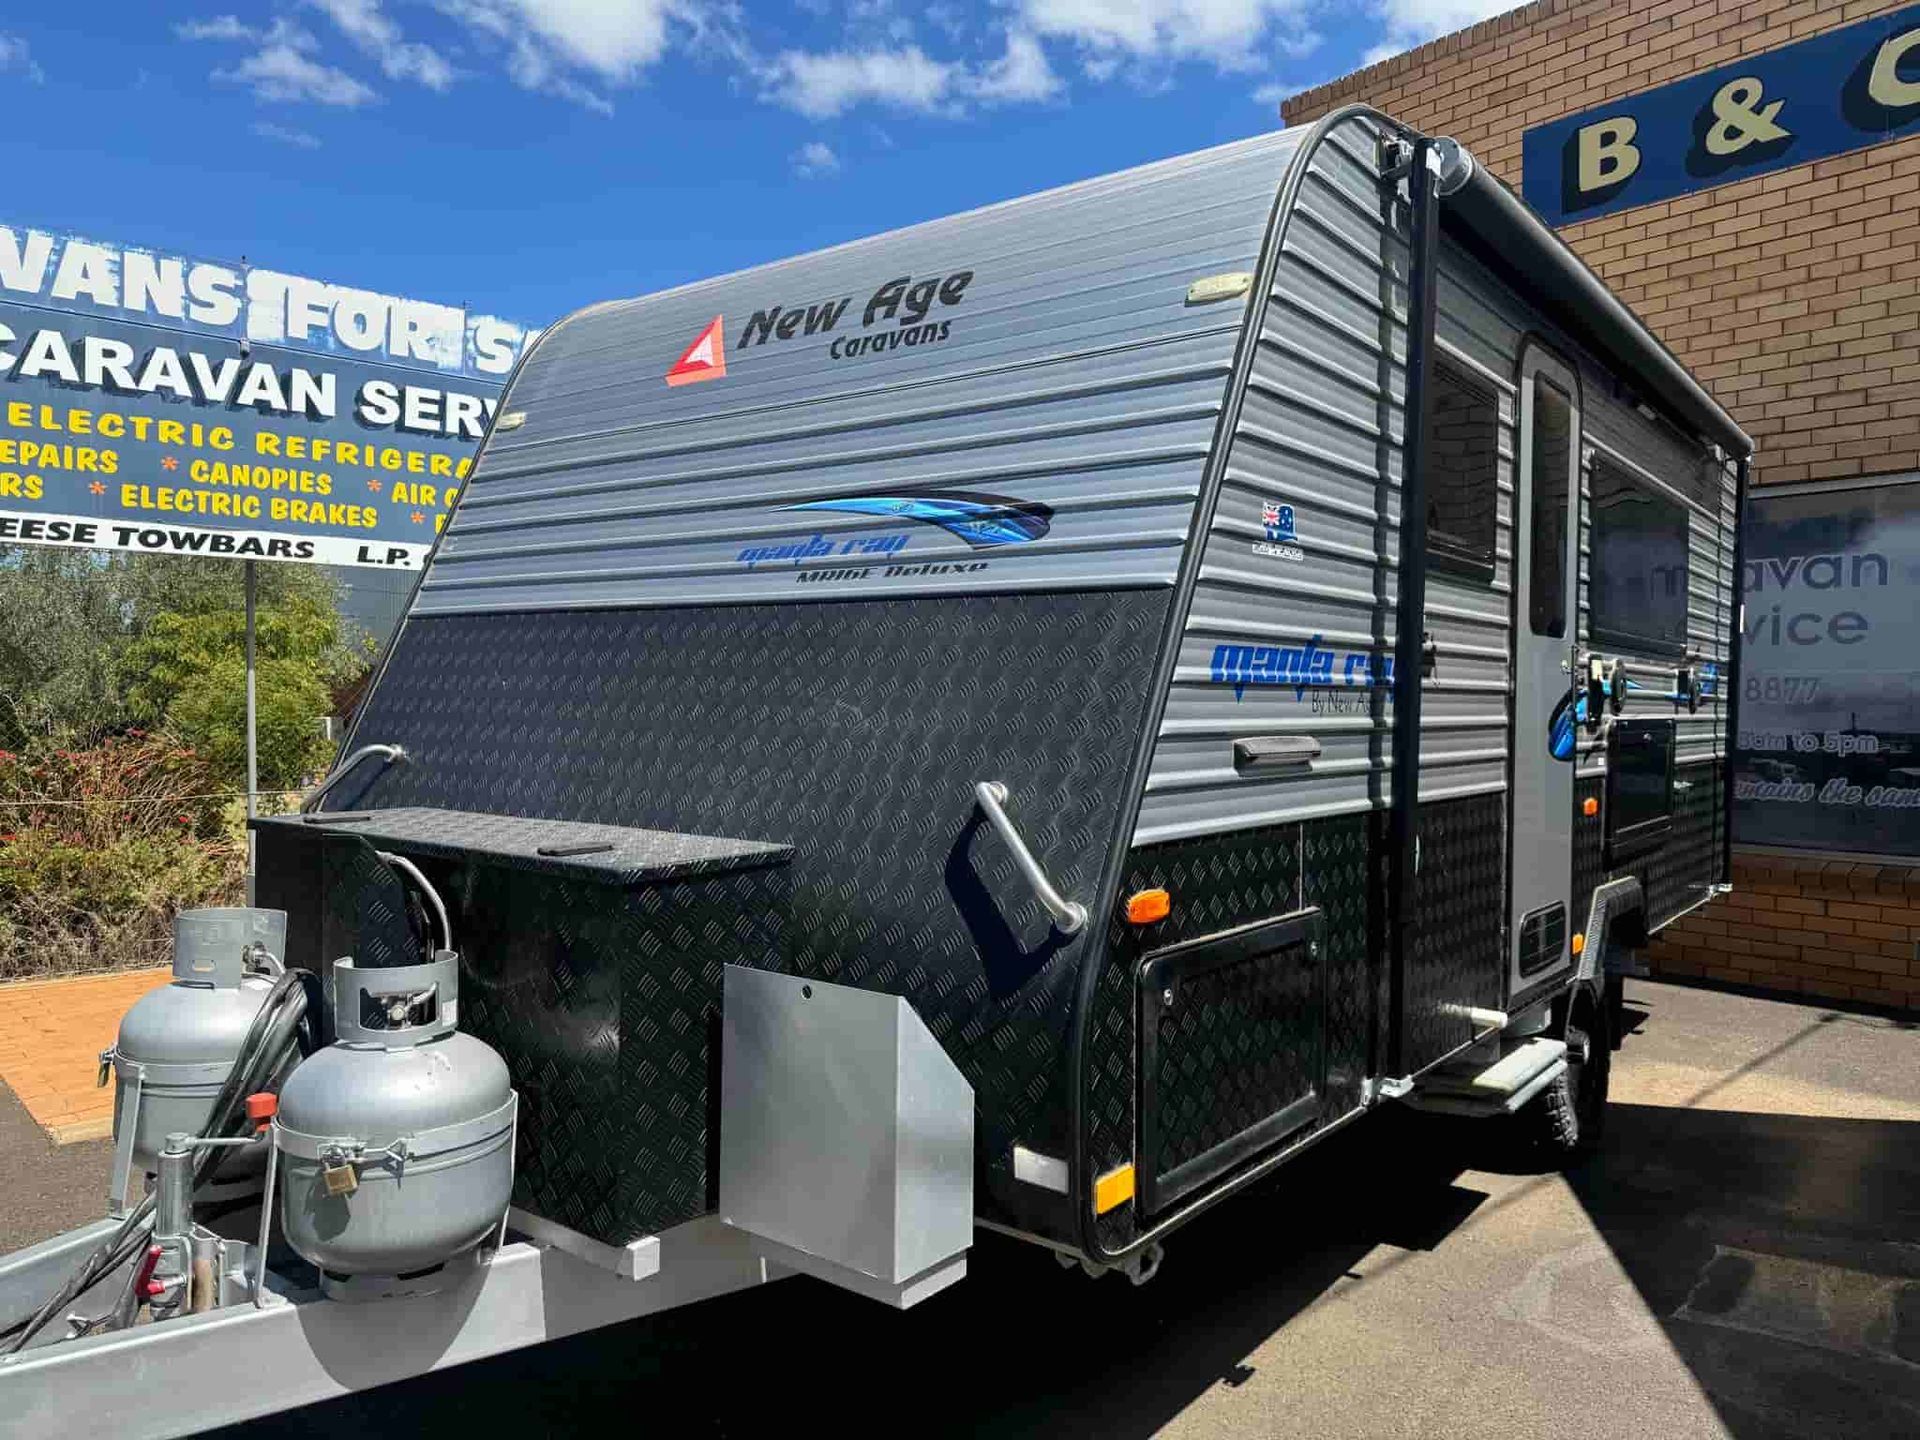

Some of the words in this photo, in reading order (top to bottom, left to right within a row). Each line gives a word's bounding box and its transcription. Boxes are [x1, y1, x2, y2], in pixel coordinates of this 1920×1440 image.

[1579, 117, 1641, 192] B
[1706, 77, 1792, 155] &
[0, 225, 241, 325] VANS
[474, 315, 540, 374] S
[737, 297, 851, 350] New
[863, 270, 974, 329] Age
[829, 318, 952, 360] Caravans
[8, 401, 235, 450] ELECTRIC
[190, 459, 333, 496] CANOPIES
[391, 480, 437, 507] AIR
[120, 483, 262, 519] ELECTRIC
[270, 497, 379, 529] BRAKES
[112, 526, 315, 560] TOWBARS
[1211, 634, 1335, 704] manta
[1311, 690, 1326, 716] By
[1327, 690, 1353, 714] New
